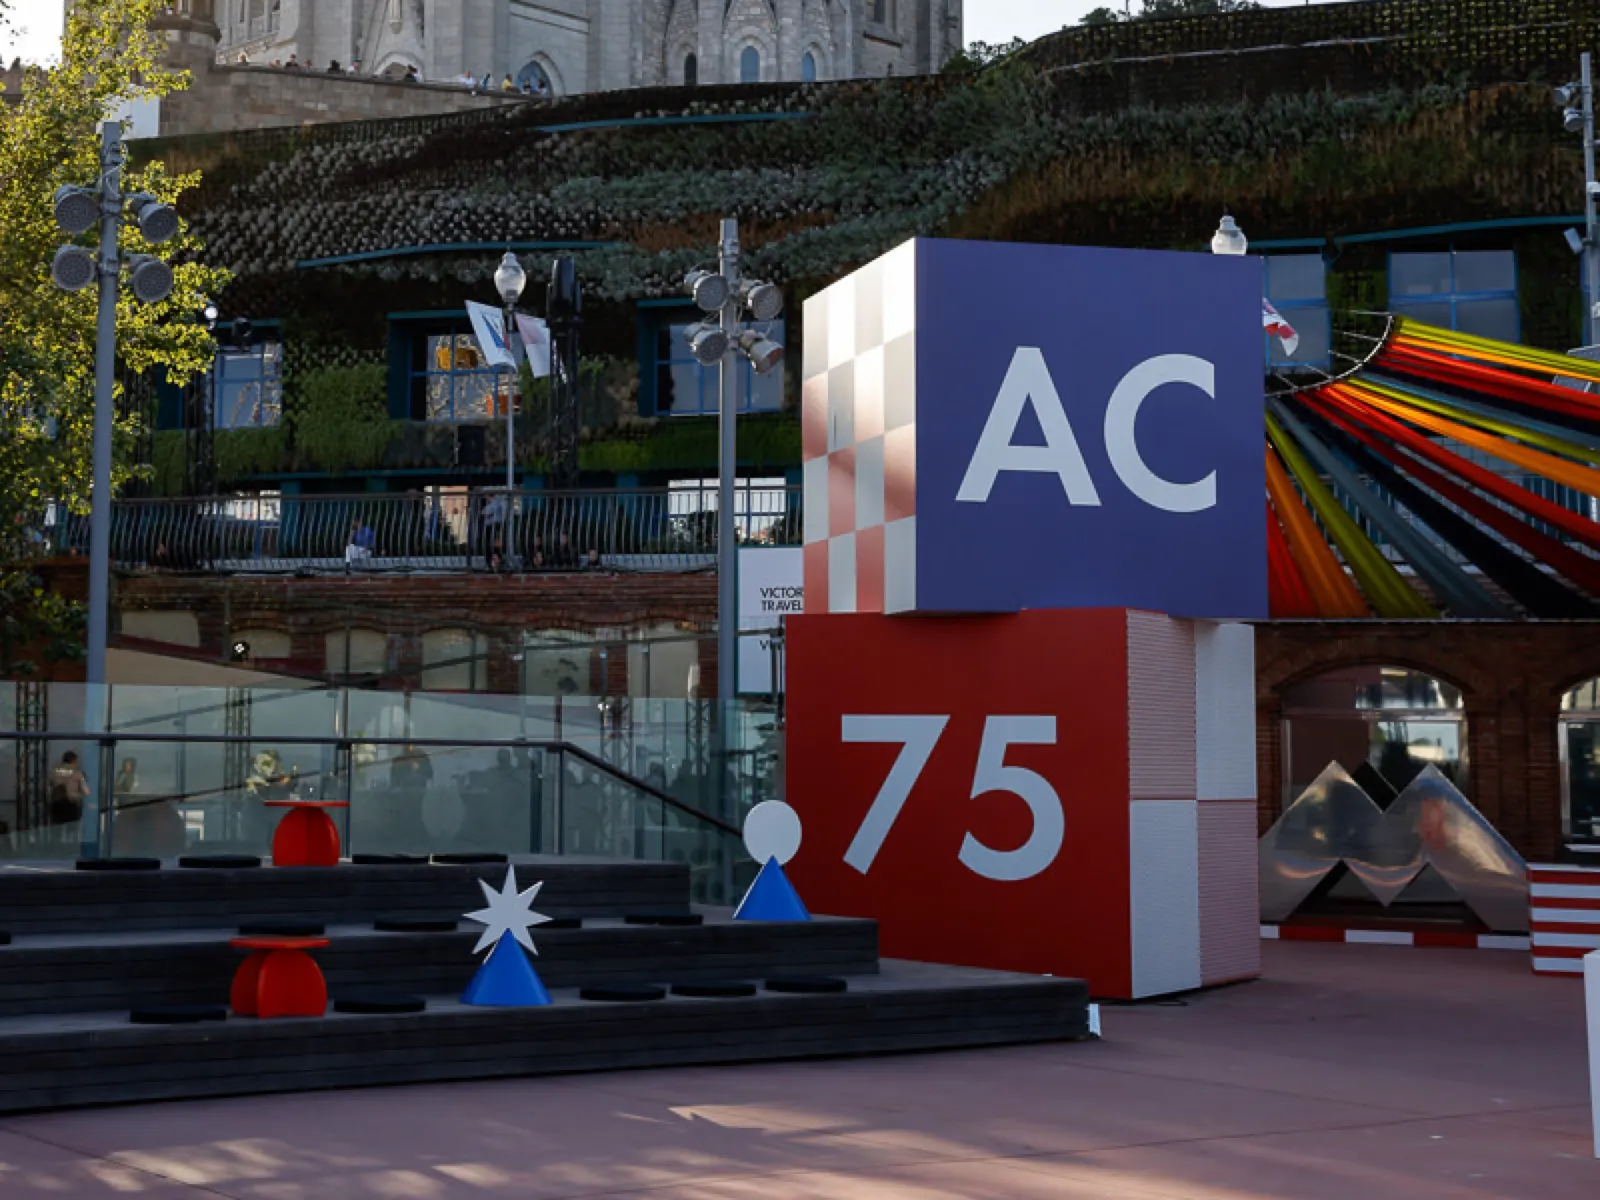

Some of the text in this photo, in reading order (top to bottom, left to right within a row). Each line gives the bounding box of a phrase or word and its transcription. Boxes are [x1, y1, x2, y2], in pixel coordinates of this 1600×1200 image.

[955, 345, 1217, 513] AC
[761, 599, 804, 612] TRAVEL
[841, 714, 1065, 881] 75
